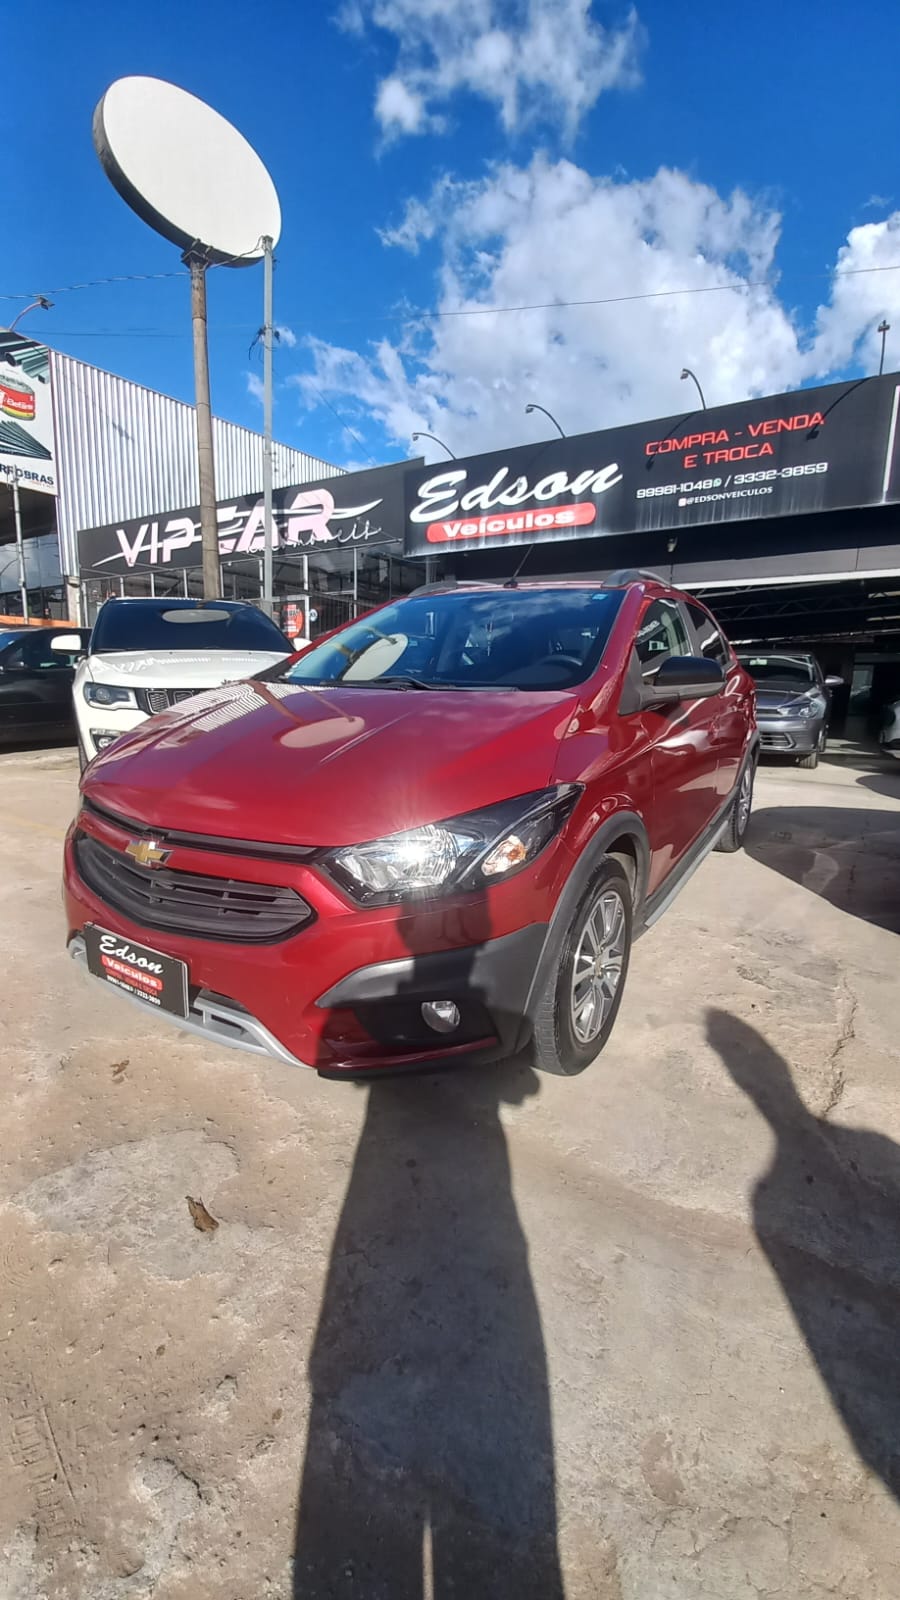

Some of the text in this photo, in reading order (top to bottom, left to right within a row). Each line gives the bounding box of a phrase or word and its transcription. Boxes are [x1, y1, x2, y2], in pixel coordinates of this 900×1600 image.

[645, 429, 730, 456] COMPRA
[748, 411, 825, 437] VENDA
[683, 442, 774, 469] E TROCA
[733, 462, 829, 485] 3332-3859
[409, 463, 623, 523] Edson
[99, 934, 164, 974] Edson
